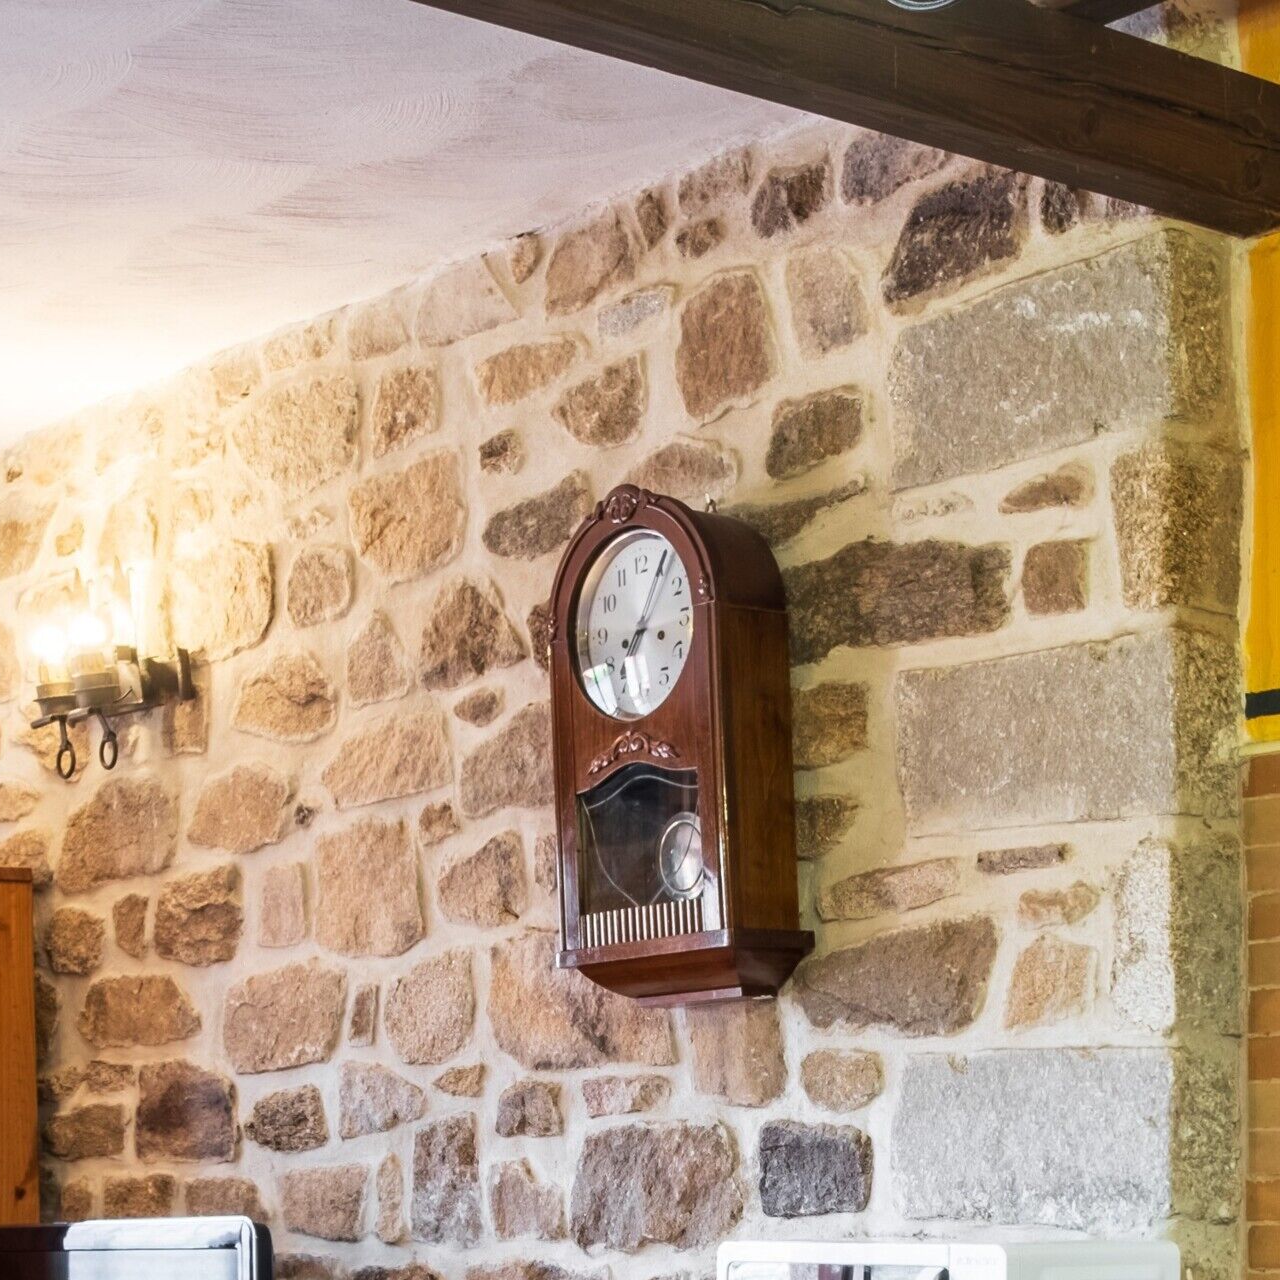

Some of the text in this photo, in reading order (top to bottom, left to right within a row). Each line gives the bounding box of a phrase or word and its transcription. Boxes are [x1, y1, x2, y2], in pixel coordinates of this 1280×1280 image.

[634, 554, 649, 575] 12
[617, 568, 627, 588] 11
[672, 576, 683, 597] 2
[603, 593, 617, 614] 10
[597, 627, 608, 646] 9
[672, 640, 683, 660] 4
[658, 666, 669, 687] 5
